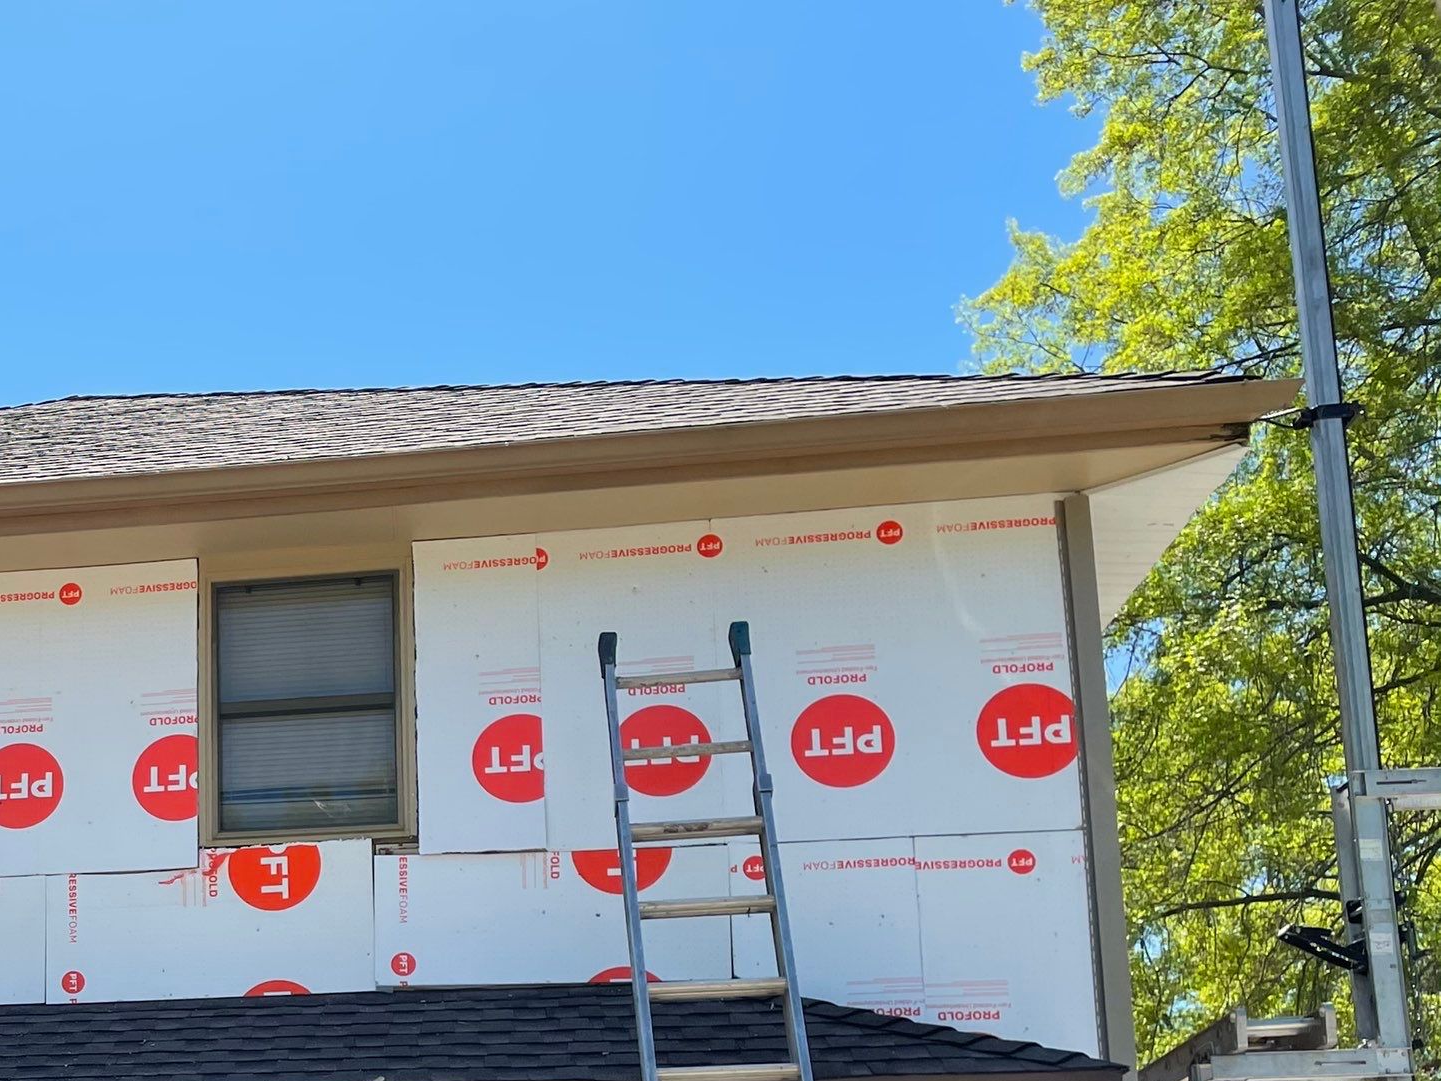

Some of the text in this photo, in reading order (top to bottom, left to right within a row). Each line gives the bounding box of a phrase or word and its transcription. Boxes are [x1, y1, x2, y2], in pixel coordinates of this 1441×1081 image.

[936, 516, 1057, 534] PROGRESSIVEFOAM
[754, 530, 872, 547] PROGRESSIVEFOAM
[878, 528, 902, 538] PFT
[579, 544, 692, 560] PROGRESSIVEFOAM
[699, 541, 721, 551] PFT
[61, 588, 81, 599] PFT
[992, 662, 1054, 674] PROFOLD
[807, 673, 867, 686] PROFOLD
[628, 683, 686, 696] PROFOLD
[991, 715, 1072, 748] PFT
[804, 725, 883, 758] PFT
[915, 858, 1002, 870] PROGRESSIVE
[1012, 857, 1033, 866] PFT
[69, 972, 78, 992] PFT
[937, 1010, 1000, 1021] PROFOLD
